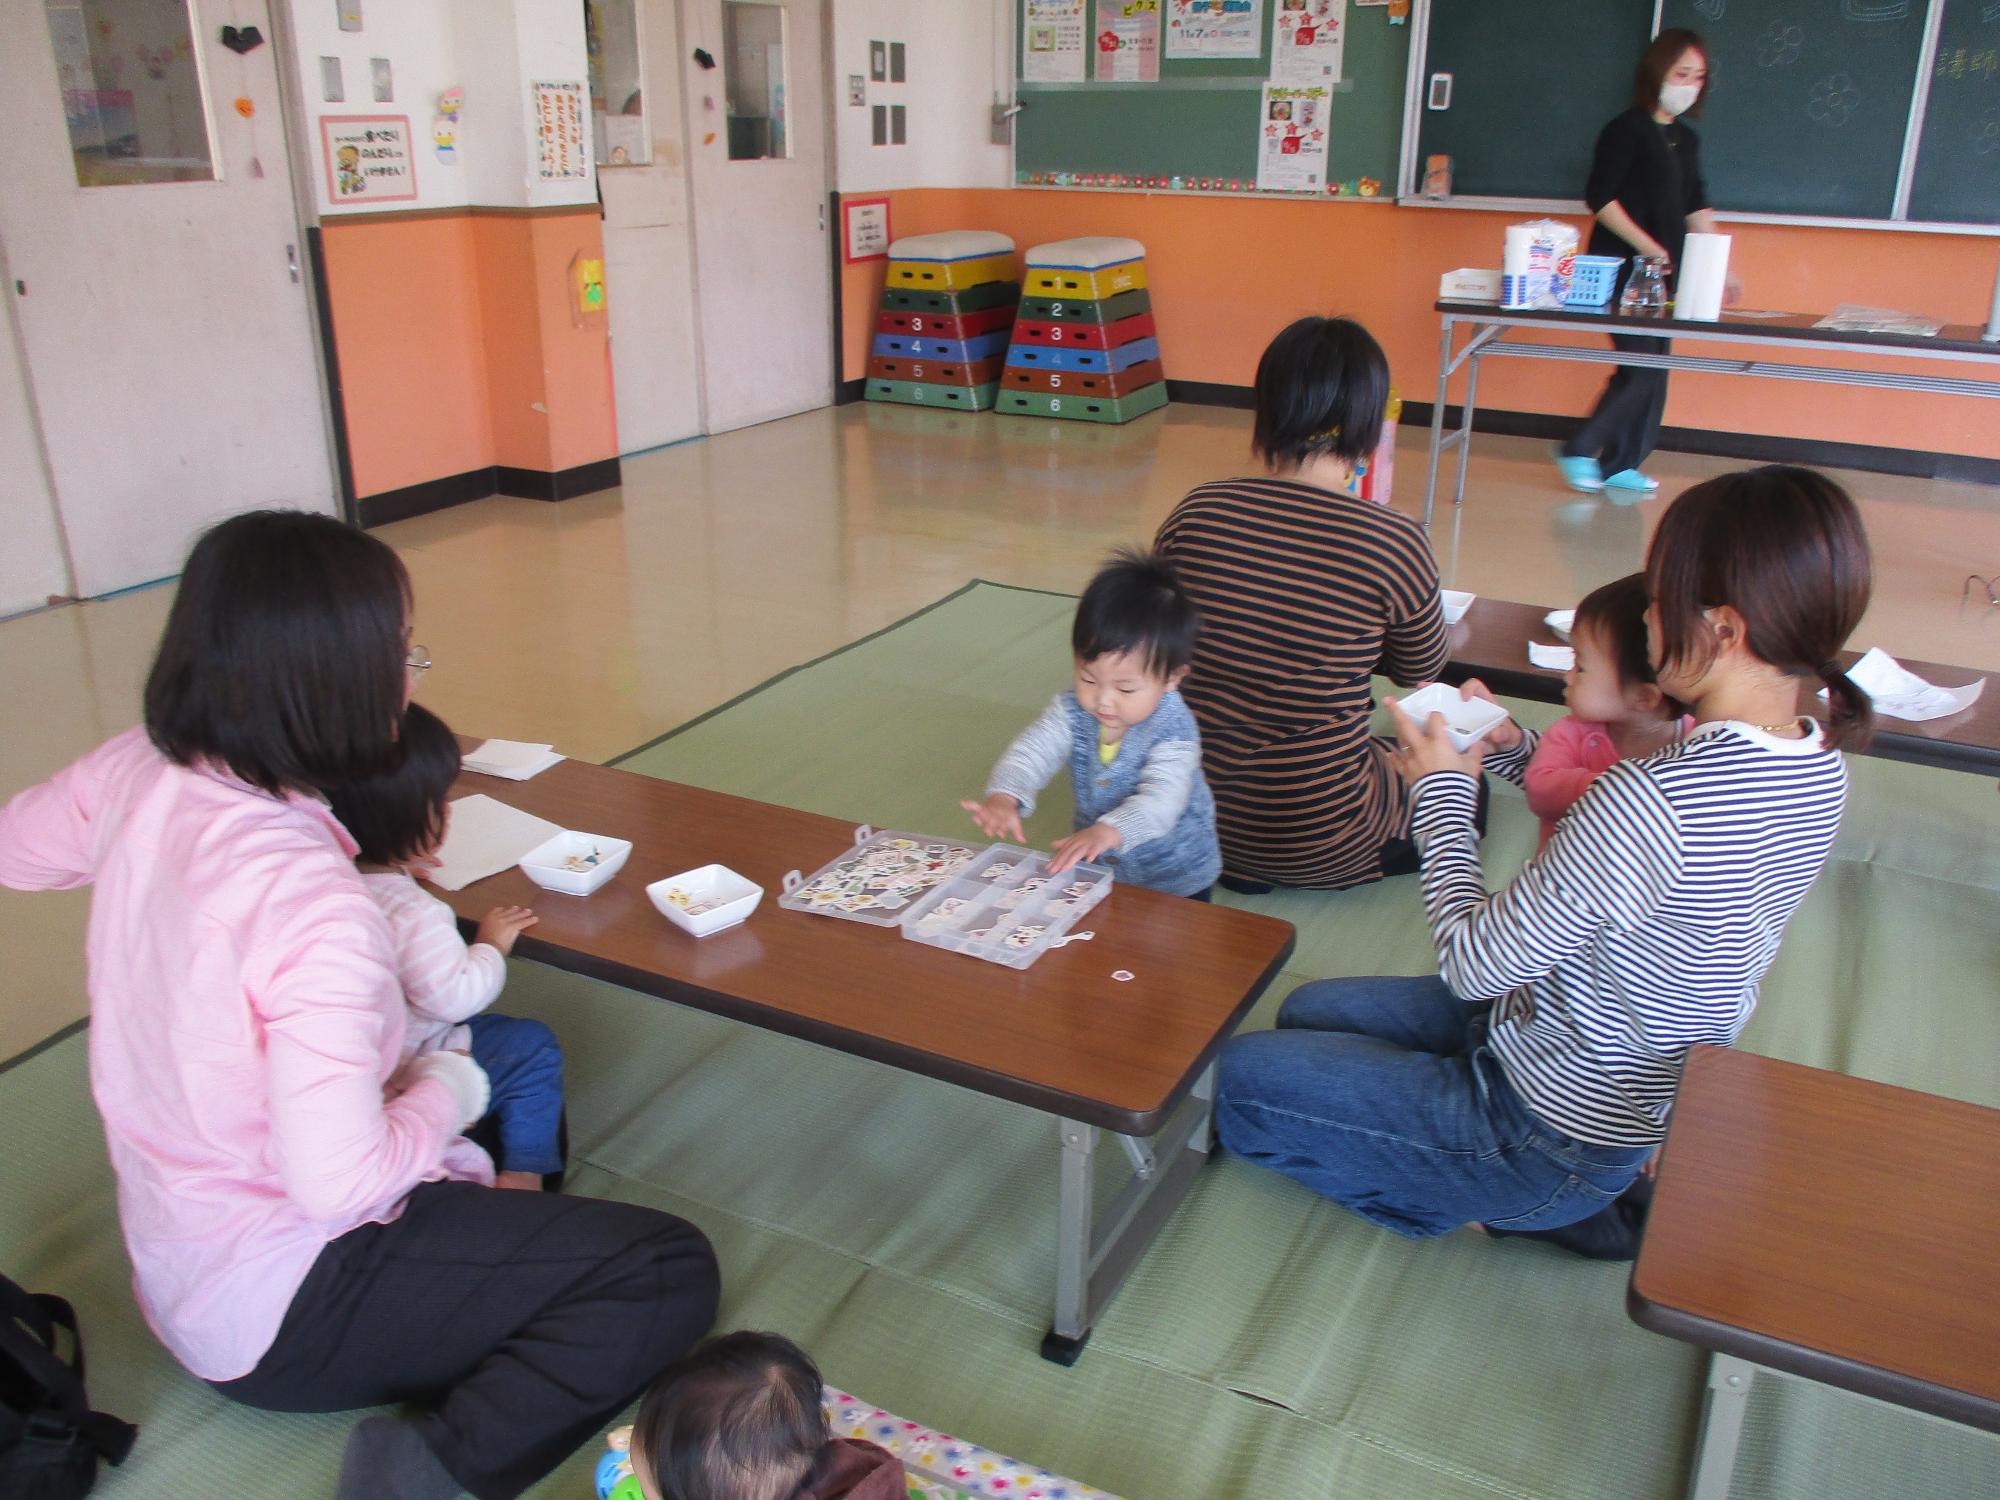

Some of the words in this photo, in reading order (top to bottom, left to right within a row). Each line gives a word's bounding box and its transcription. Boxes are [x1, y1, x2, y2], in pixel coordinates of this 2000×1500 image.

[1055, 276, 1061, 288] 1
[1052, 303, 1062, 316] 2
[911, 318, 922, 331] 3
[1052, 328, 1062, 340] 3
[911, 340, 922, 353] 4
[1051, 352, 1061, 365] 4
[912, 365, 923, 378] 5
[1050, 375, 1061, 388] 5
[914, 387, 923, 400] 6
[1050, 399, 1061, 412] 6
